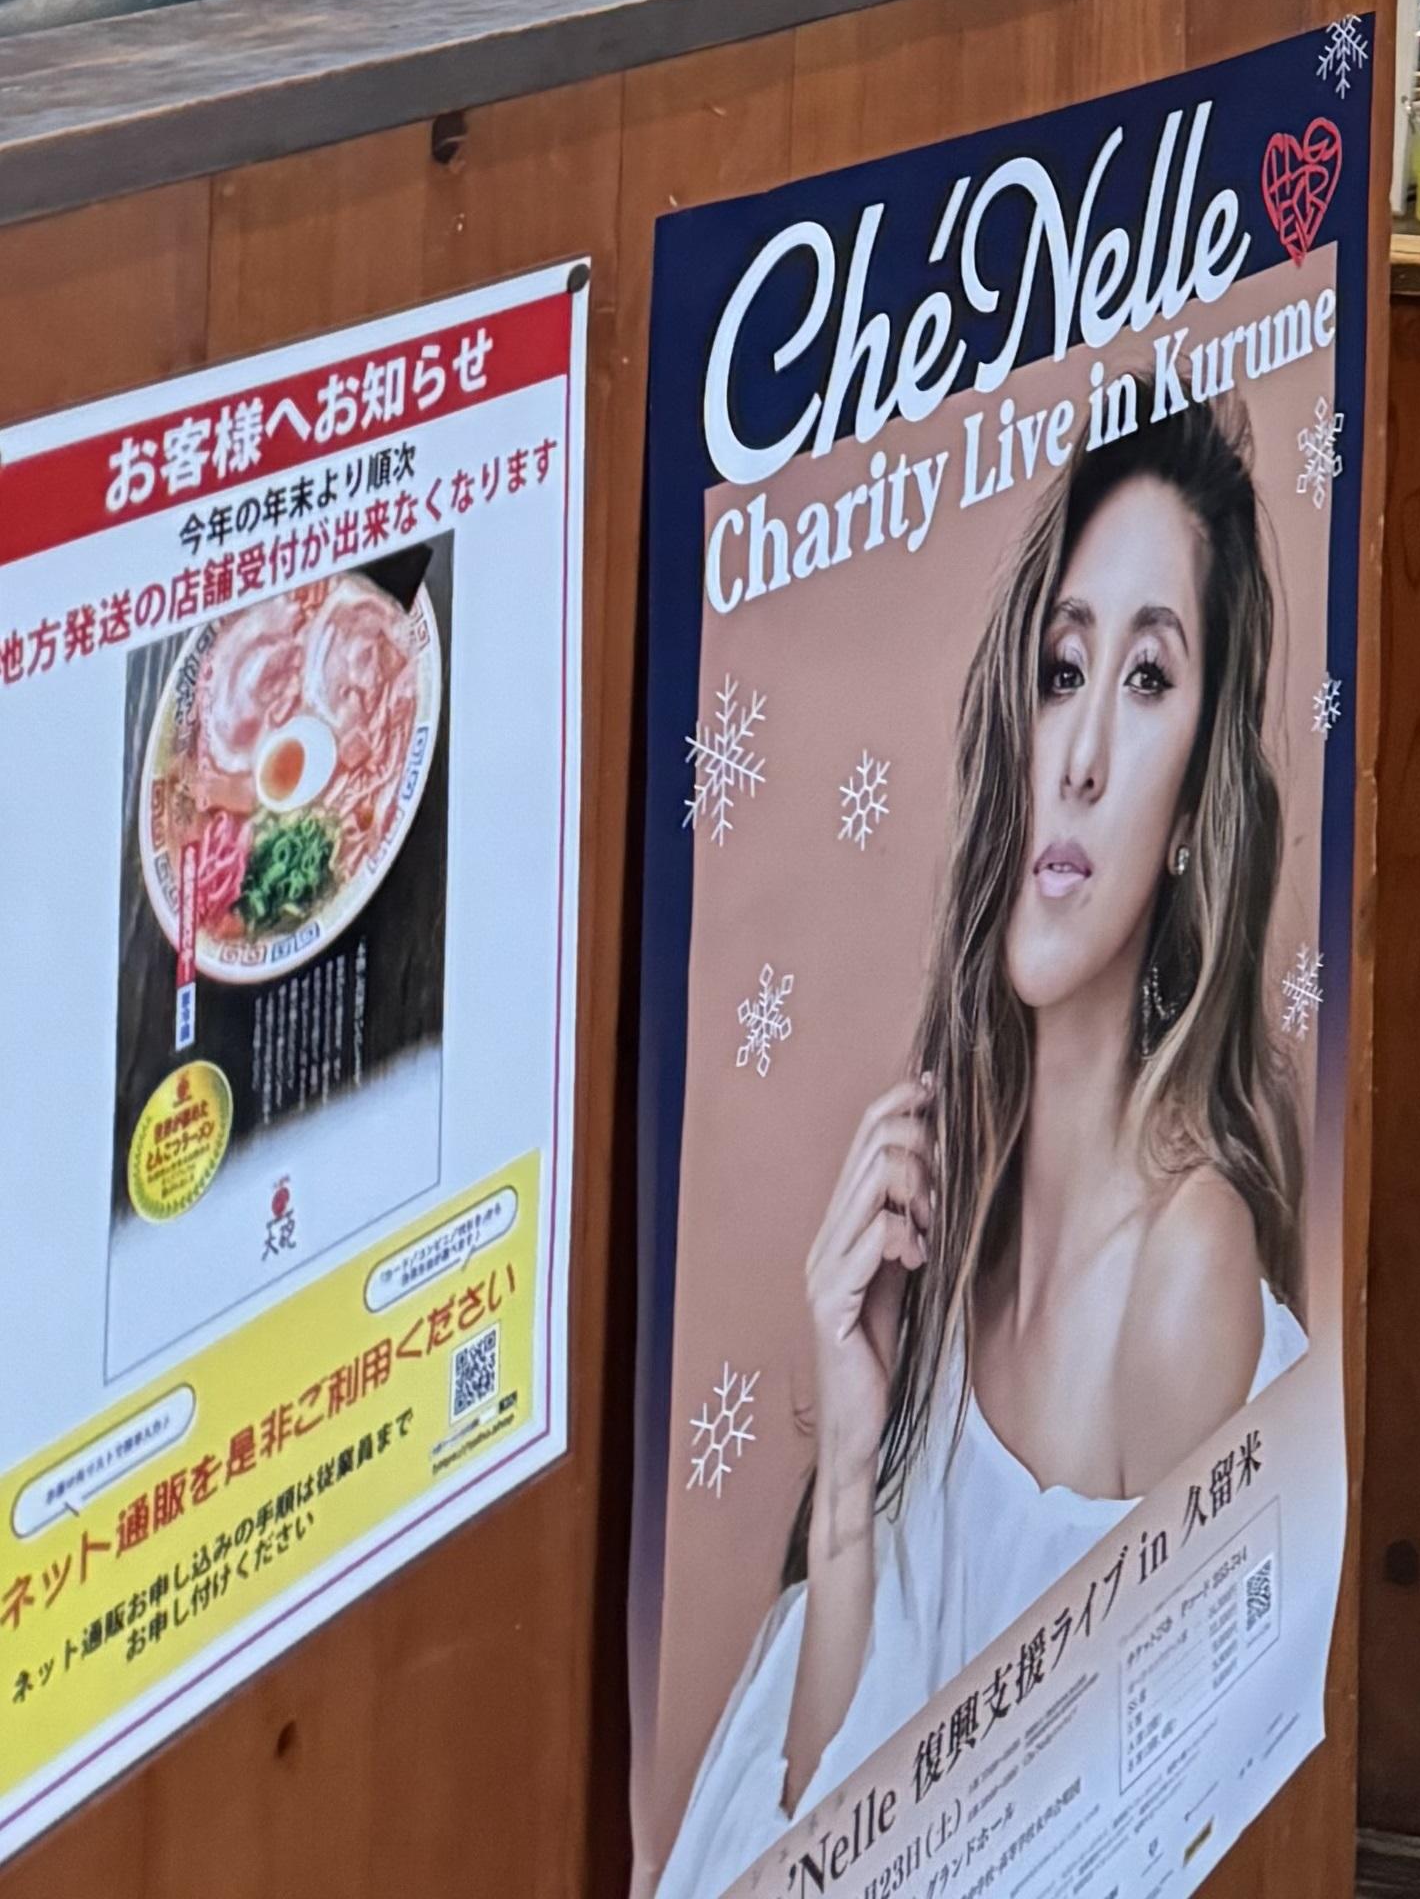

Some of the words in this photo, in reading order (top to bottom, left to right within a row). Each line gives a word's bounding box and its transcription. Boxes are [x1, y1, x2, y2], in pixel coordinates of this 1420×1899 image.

[105, 327, 494, 513] お客様へお知らせ
[179, 441, 417, 555] 今年の年末より順次
[706, 450, 949, 614] Charity
[960, 398, 1075, 509] Live
[1086, 361, 1139, 453] in
[1150, 288, 1337, 423] Kurume
[0, 437, 558, 685] 地方発送の店舗受付が出来なくなります
[0, 1262, 516, 1630] ネット通販を是非ご利用ください
[12, 1407, 414, 1703] ネット通販お申し込みの手順は従業員まで
[126, 1511, 316, 1662] お申し付けください
[911, 1546, 1129, 1803] 復興支援ライブ
[1139, 1530, 1170, 1585] in
[1181, 1429, 1264, 1549] 久留米
